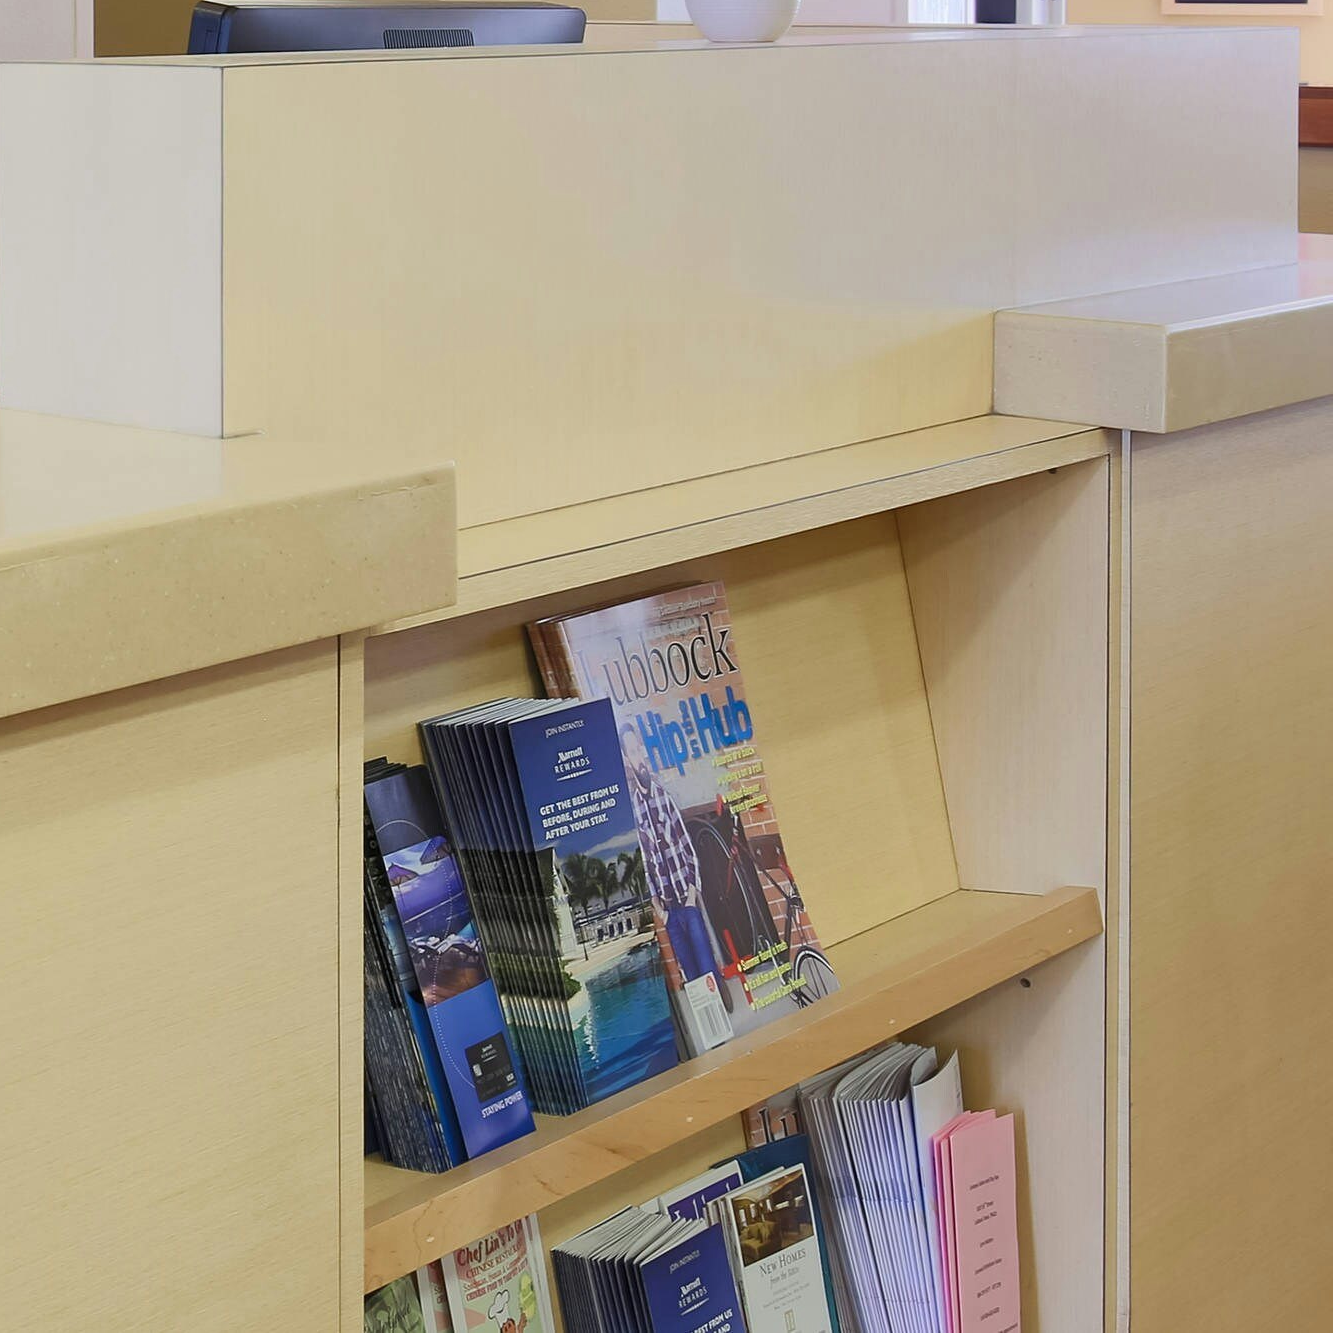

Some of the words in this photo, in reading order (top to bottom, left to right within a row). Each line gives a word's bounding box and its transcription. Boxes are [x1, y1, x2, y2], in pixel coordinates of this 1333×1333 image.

[689, 686, 753, 753] Hub
[636, 711, 688, 776] Hip
[554, 757, 590, 774] REWARDS
[540, 804, 555, 815] GET
[556, 799, 572, 811] THE
[572, 794, 589, 806] BEST
[590, 788, 609, 800] FROM
[609, 784, 619, 794] US
[542, 812, 572, 828] BEFORE,
[573, 804, 600, 818] DURING
[600, 798, 616, 809] AND
[545, 826, 570, 840] AFTER
[570, 820, 591, 832] YOUR
[591, 814, 608, 825] STAY.
[482, 1099, 505, 1118] STAYING
[504, 1090, 523, 1106] POWER
[457, 1241, 483, 1266] Chef
